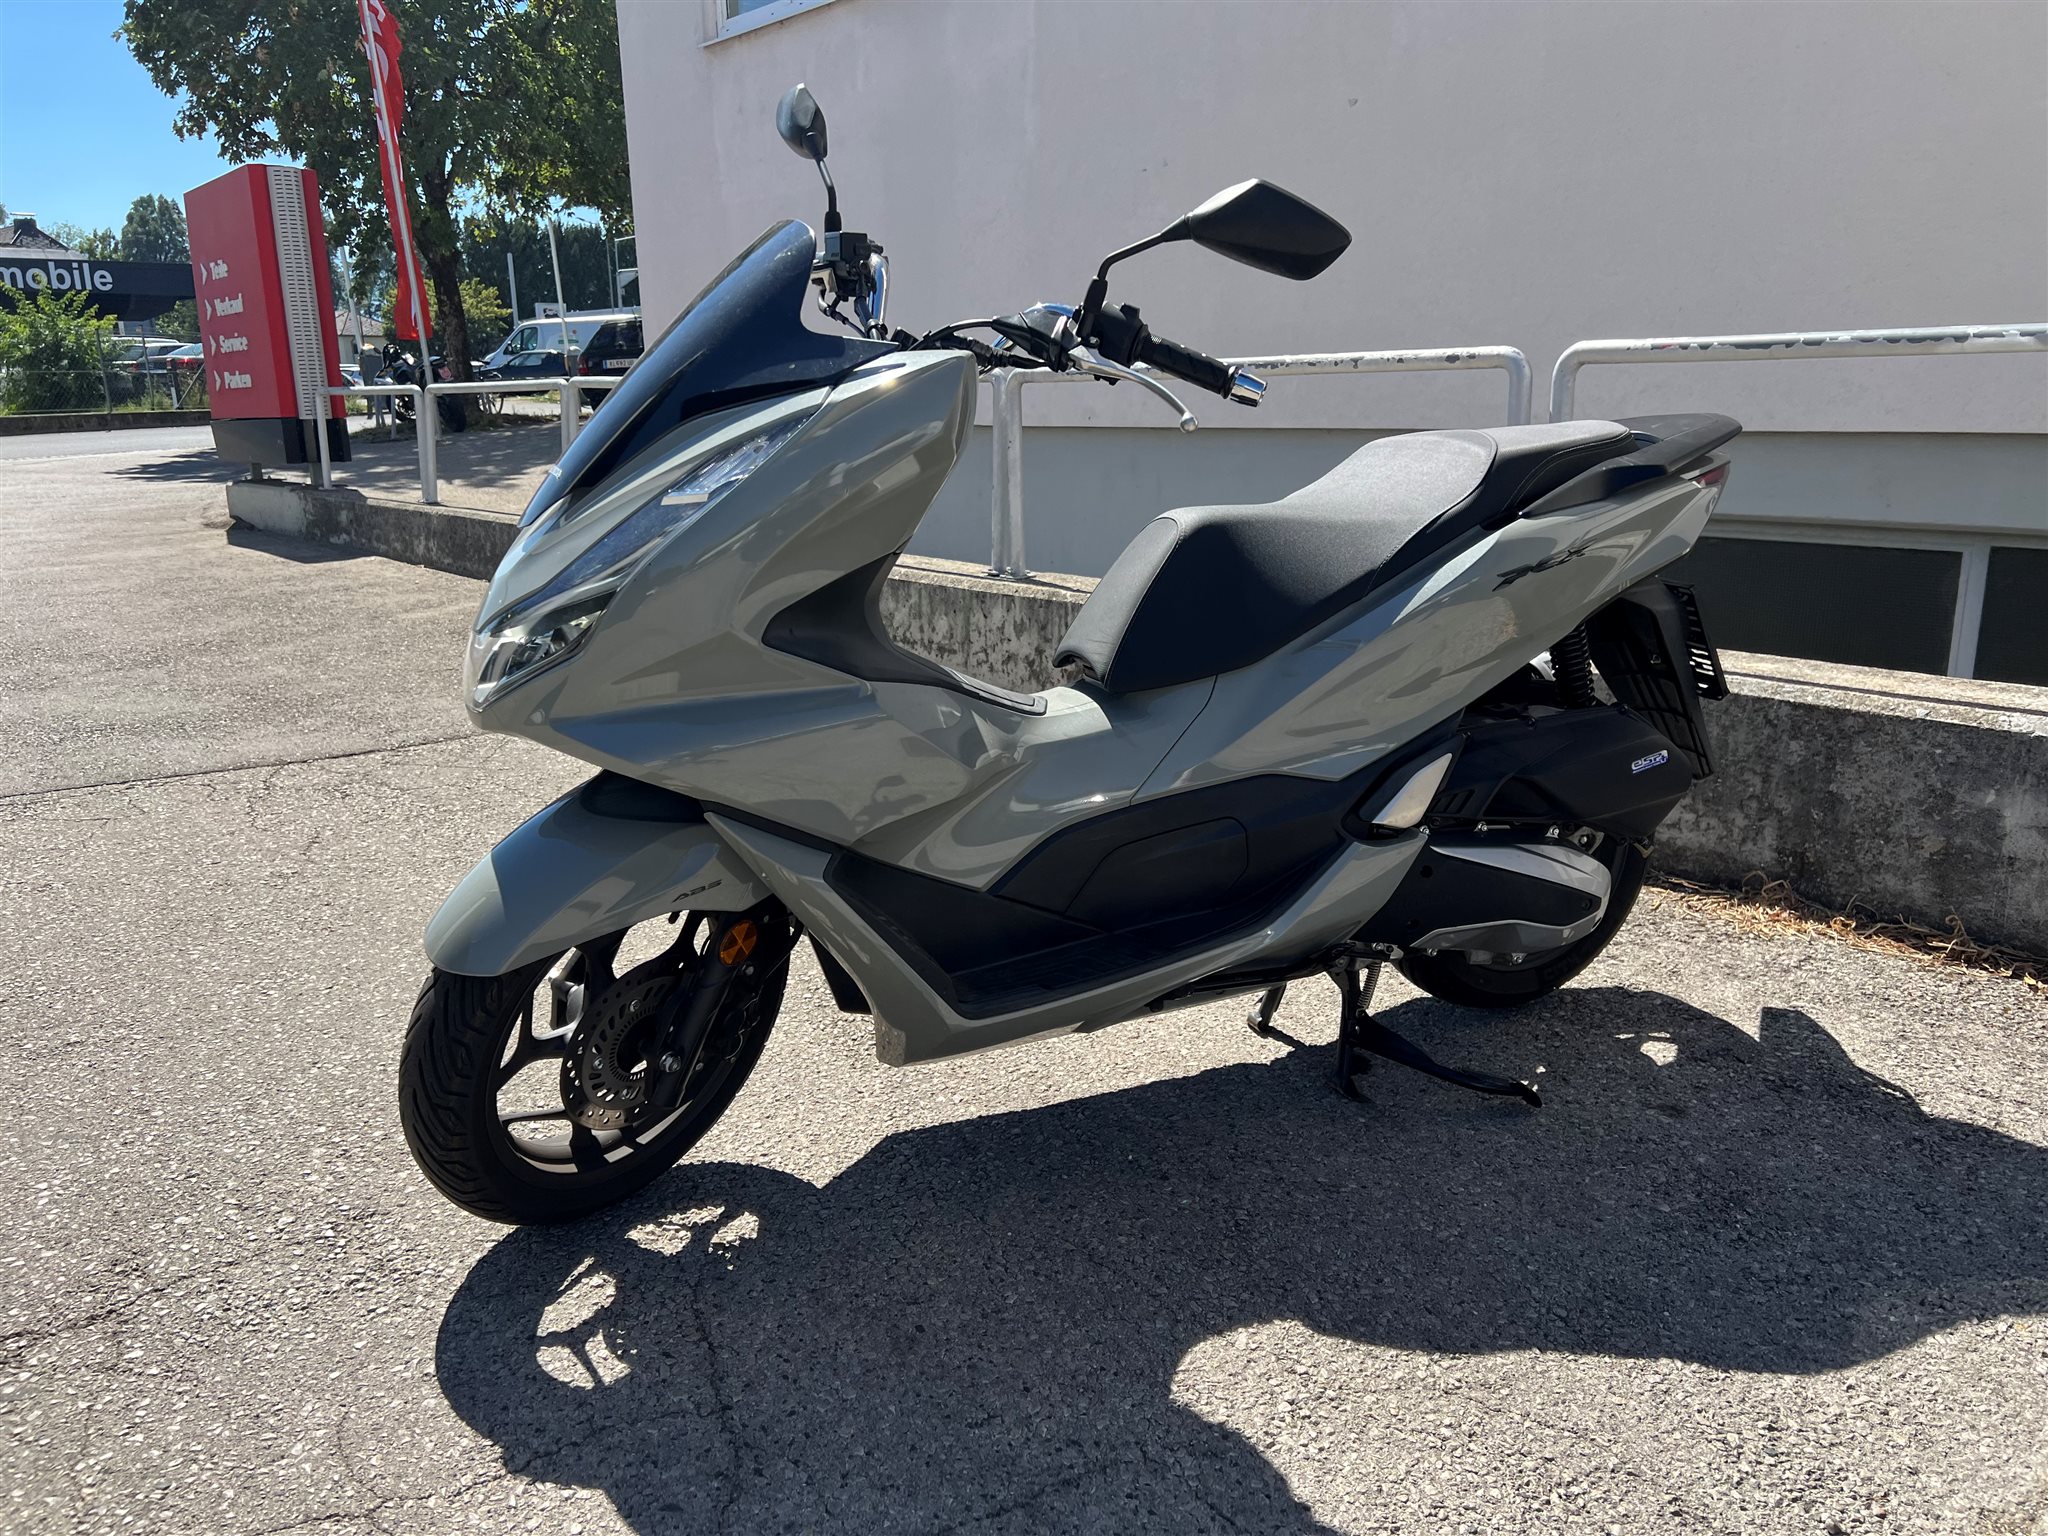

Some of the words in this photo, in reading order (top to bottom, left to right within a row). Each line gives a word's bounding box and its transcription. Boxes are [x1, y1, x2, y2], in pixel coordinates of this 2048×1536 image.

[0, 261, 113, 291] mobile
[210, 259, 228, 280] Teile
[219, 332, 248, 353] Service
[224, 370, 252, 389] Parken
[672, 879, 723, 903] ABS
